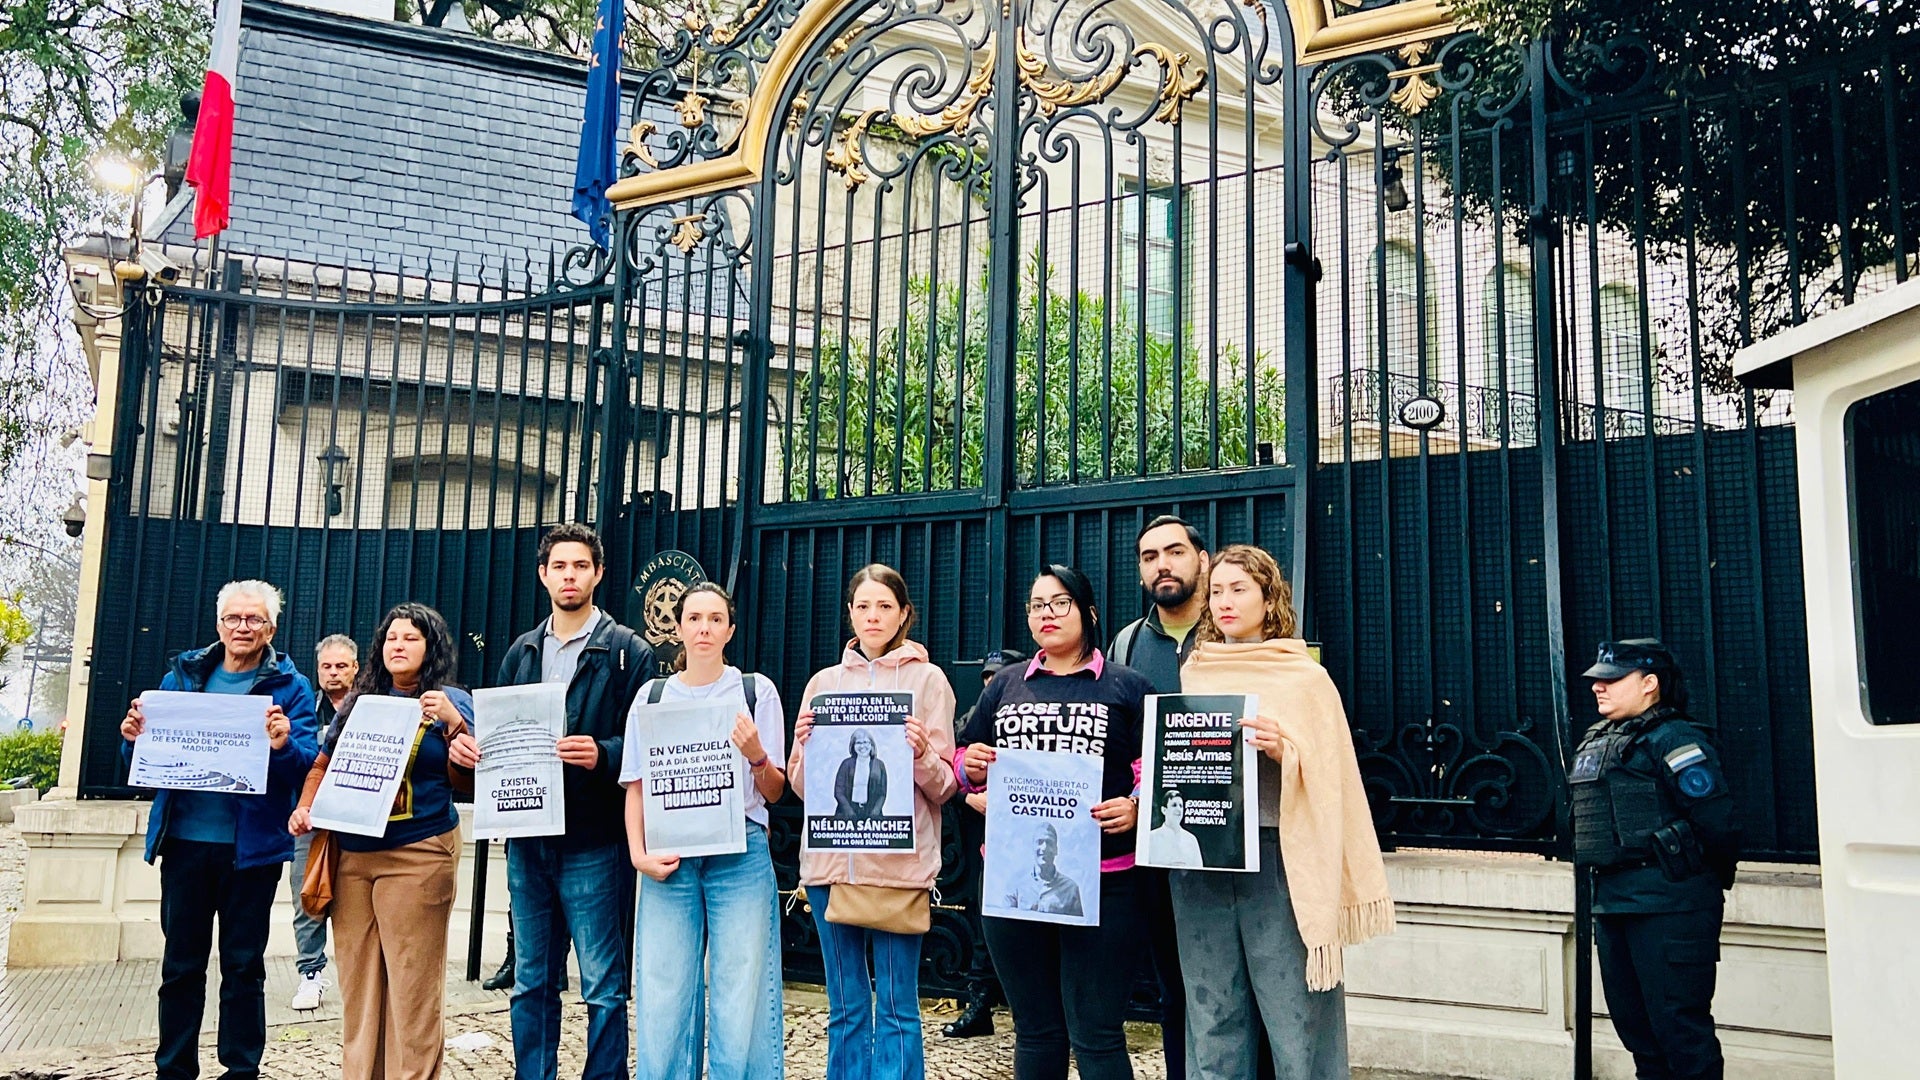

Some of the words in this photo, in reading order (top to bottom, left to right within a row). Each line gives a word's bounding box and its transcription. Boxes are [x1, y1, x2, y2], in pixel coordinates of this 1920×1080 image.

[1408, 405, 1434, 420] 2100
[634, 554, 700, 594] AMBASCIAT
[825, 698, 869, 706] DETENIDA
[812, 706, 846, 714] CENTRO
[862, 705, 908, 713] TORTURAS
[996, 702, 1062, 718] CLOSE
[1066, 703, 1109, 720] THE
[830, 714, 841, 722] EL
[1165, 712, 1232, 728] URGENTE
[995, 715, 1108, 738] TORTURE
[152, 728, 171, 736] ESTE
[197, 731, 251, 740] TERRORISMO
[166, 736, 199, 744] ESTADO
[344, 731, 354, 739] EN
[356, 732, 404, 745] VENEZUELA
[378, 745, 403, 754] VIOLAN
[650, 747, 664, 756] EN
[668, 740, 730, 754] VENEZUELA
[996, 734, 1105, 756] CENTERS
[690, 756, 700, 764] SE
[702, 753, 732, 762] VIOLAN
[1162, 748, 1194, 761] Jesús
[1194, 749, 1232, 761] Armas
[348, 760, 397, 778] DERECHOS
[335, 772, 383, 790] HUMANOS
[501, 776, 538, 787] EXISTEN
[652, 778, 673, 794] LOS
[674, 772, 732, 791] DERECHOS
[1003, 776, 1044, 786] EXIGIMOS
[1046, 779, 1089, 790] LIBERTAD
[491, 788, 534, 798] CENTROS
[536, 787, 547, 795] DE
[1008, 785, 1054, 794] INMEDIATA
[1057, 788, 1081, 796] PARA
[498, 798, 542, 809] TORTURA
[665, 789, 720, 808] HUMANOS
[1009, 793, 1078, 807] OSWALDO
[1221, 801, 1232, 809] SU
[1012, 805, 1074, 820] CASTILLO
[1185, 808, 1224, 817] APARICIÓN
[810, 818, 854, 831] NÉLIDA
[857, 818, 910, 831] SÁNCHEZ
[1184, 816, 1227, 825] INMEDIATA!
